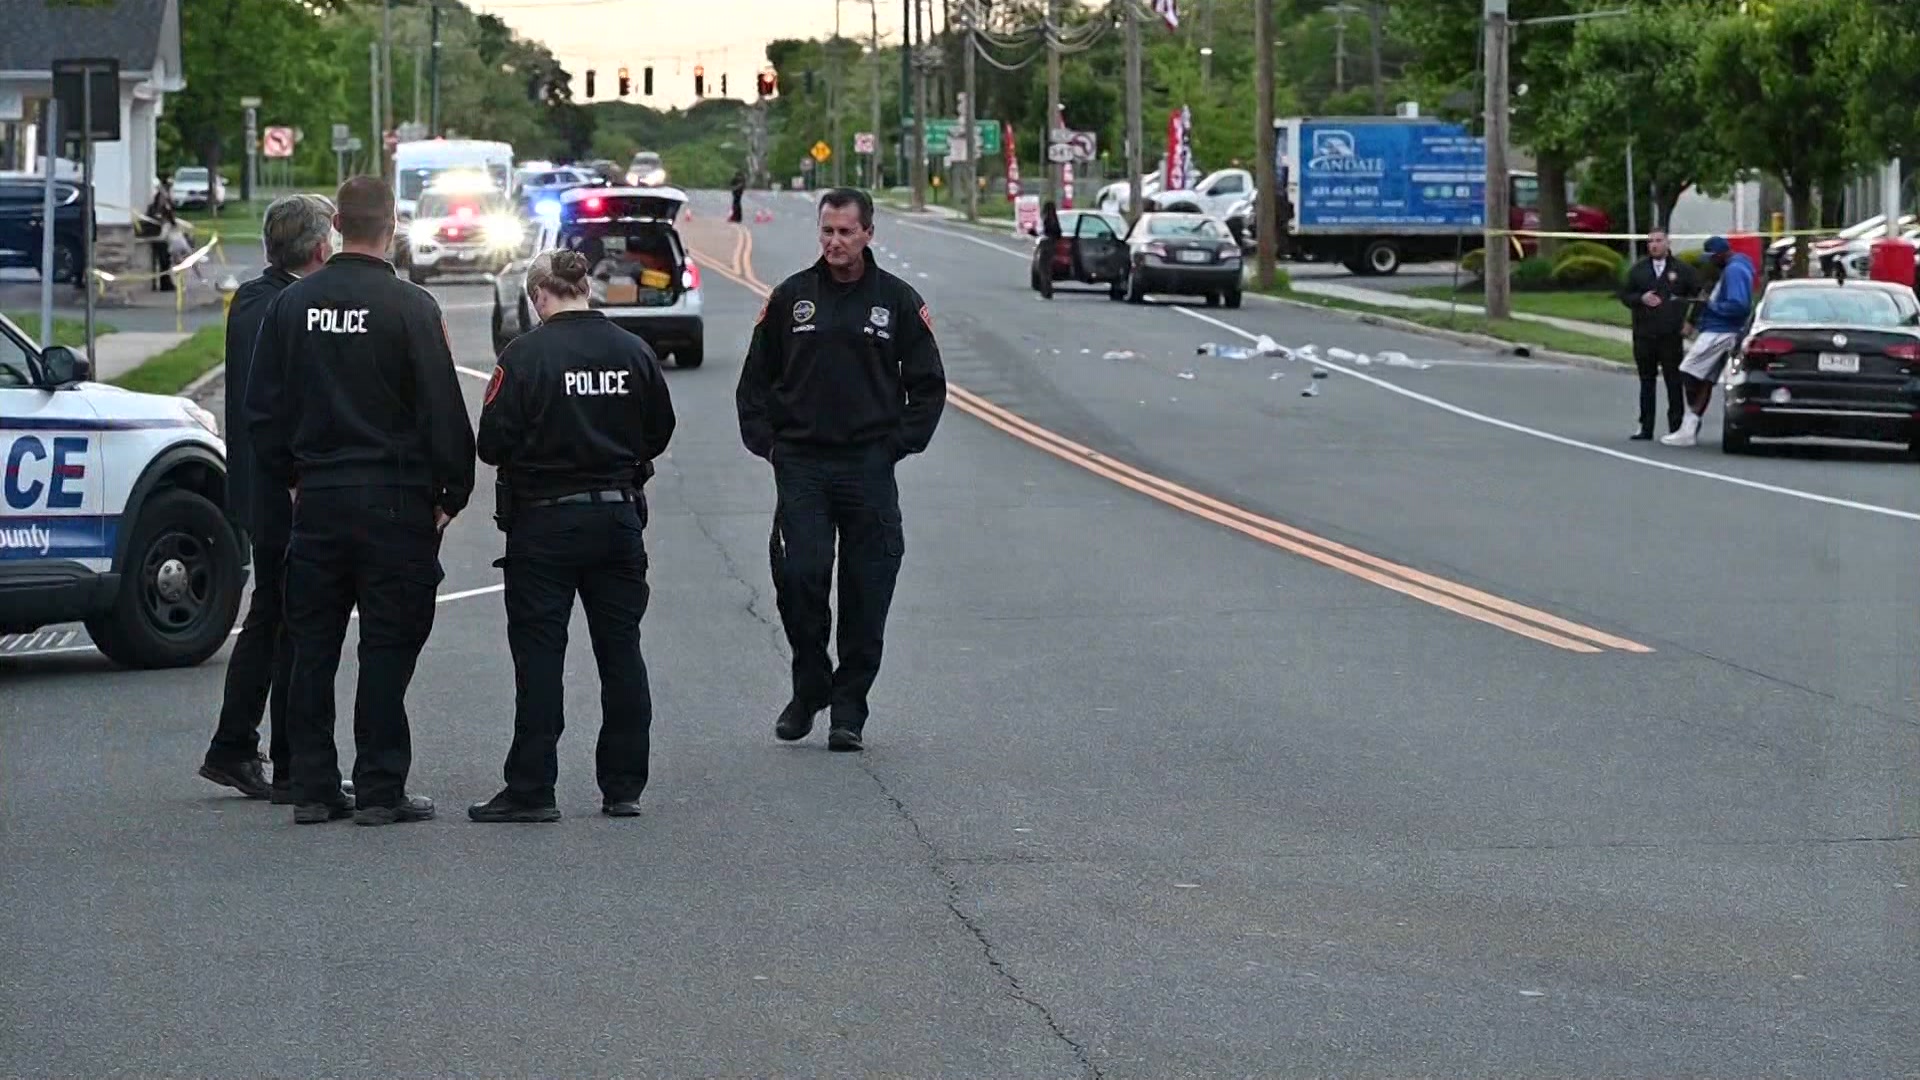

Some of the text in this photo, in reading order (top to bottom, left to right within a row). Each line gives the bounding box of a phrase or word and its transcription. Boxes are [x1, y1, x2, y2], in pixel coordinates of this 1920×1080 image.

[307, 307, 370, 333] POLICE
[564, 370, 629, 395] POLICE
[4, 435, 89, 509] CE
